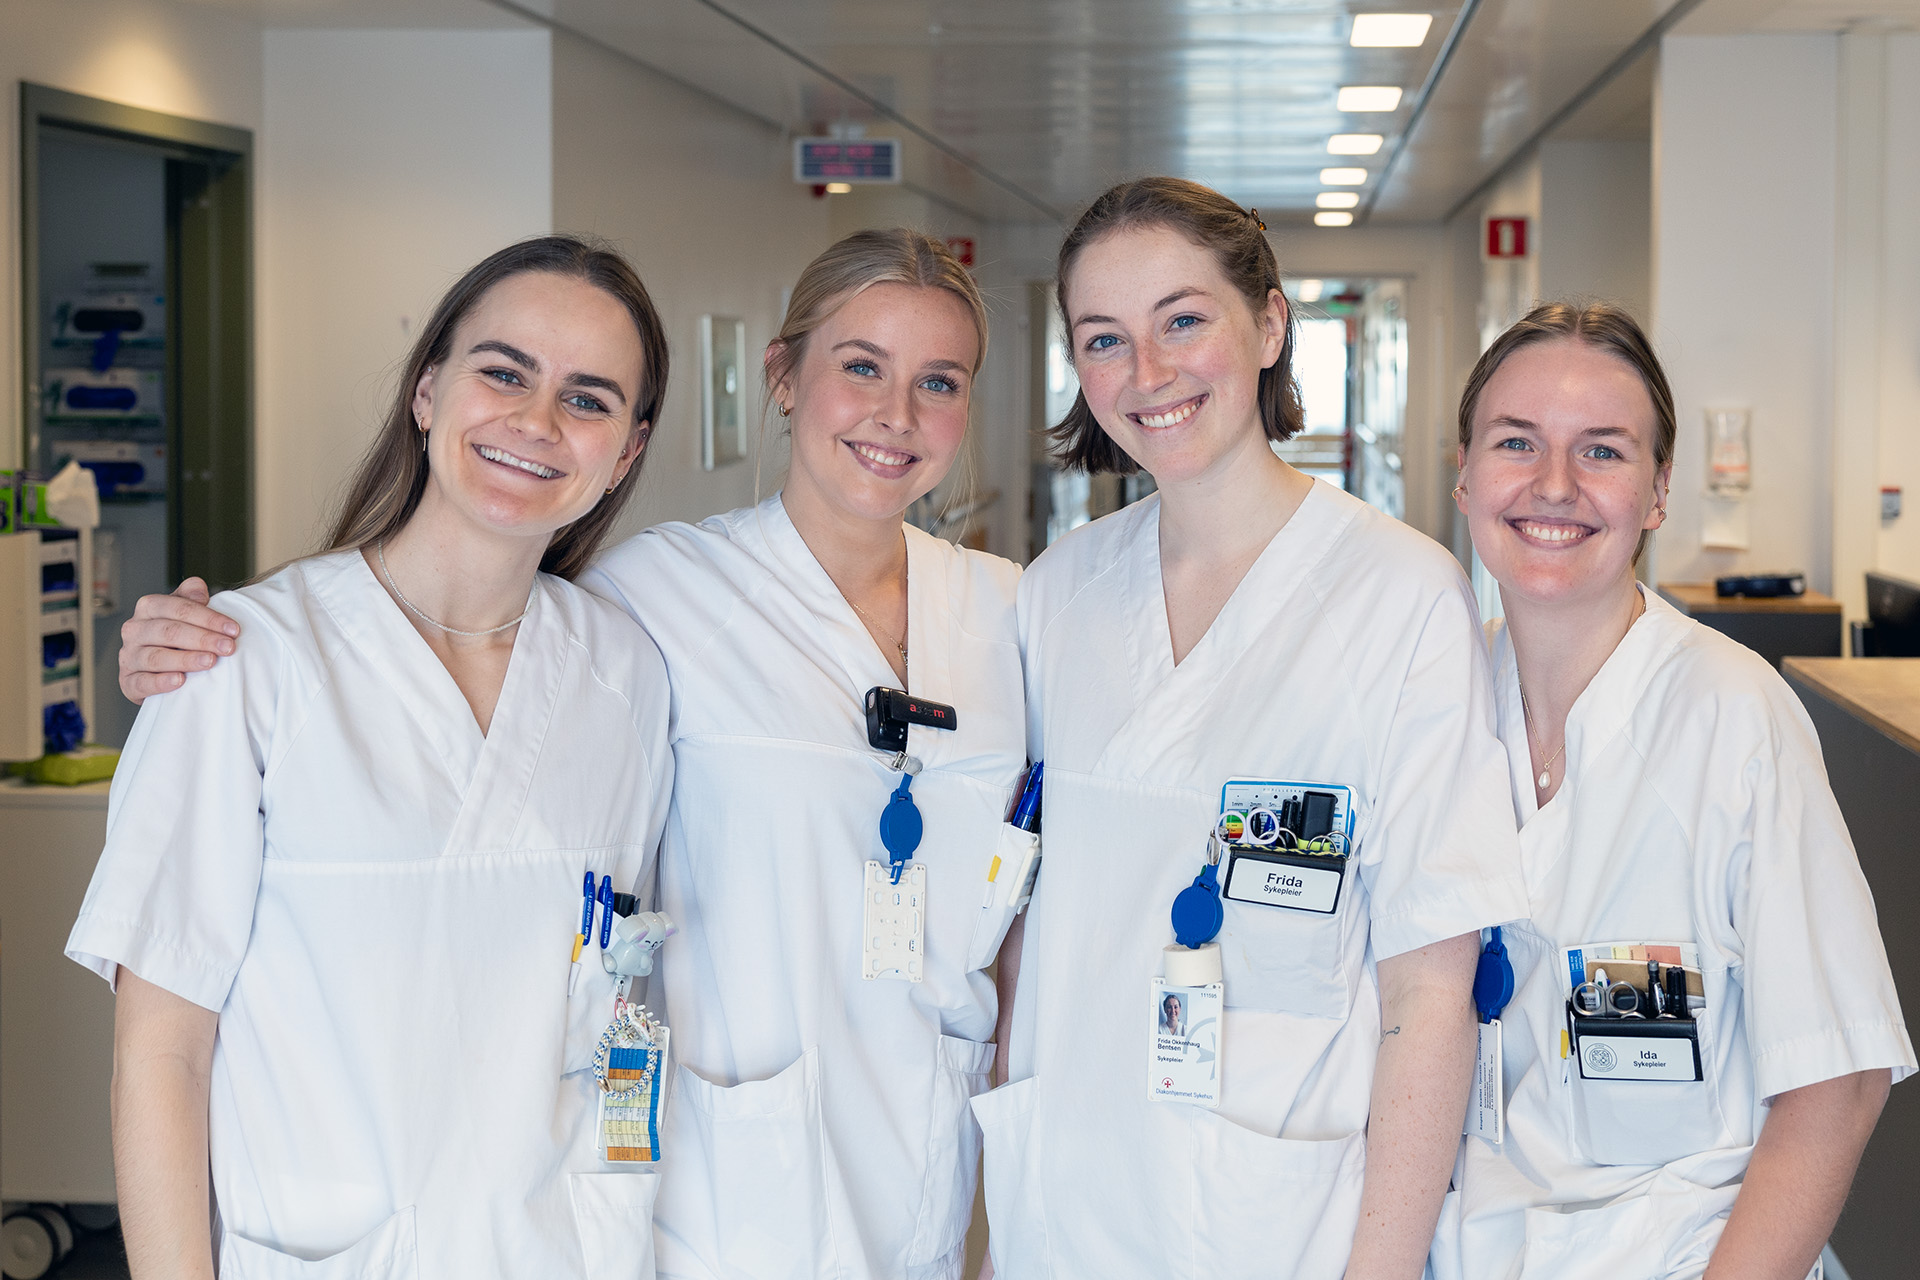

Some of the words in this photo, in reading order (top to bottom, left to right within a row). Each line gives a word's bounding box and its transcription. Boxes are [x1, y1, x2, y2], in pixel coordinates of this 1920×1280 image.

[1267, 872, 1303, 888] Frida
[1263, 884, 1303, 897] Sykepleier
[1157, 1043, 1181, 1051] Bentsen
[1157, 1055, 1183, 1063] Sykepleier
[1640, 1050, 1658, 1060] Ida
[1633, 1060, 1667, 1068] Sykepleier
[1155, 1088, 1193, 1098] Diakonhjemmet
[1193, 1092, 1213, 1100] Sykehus
